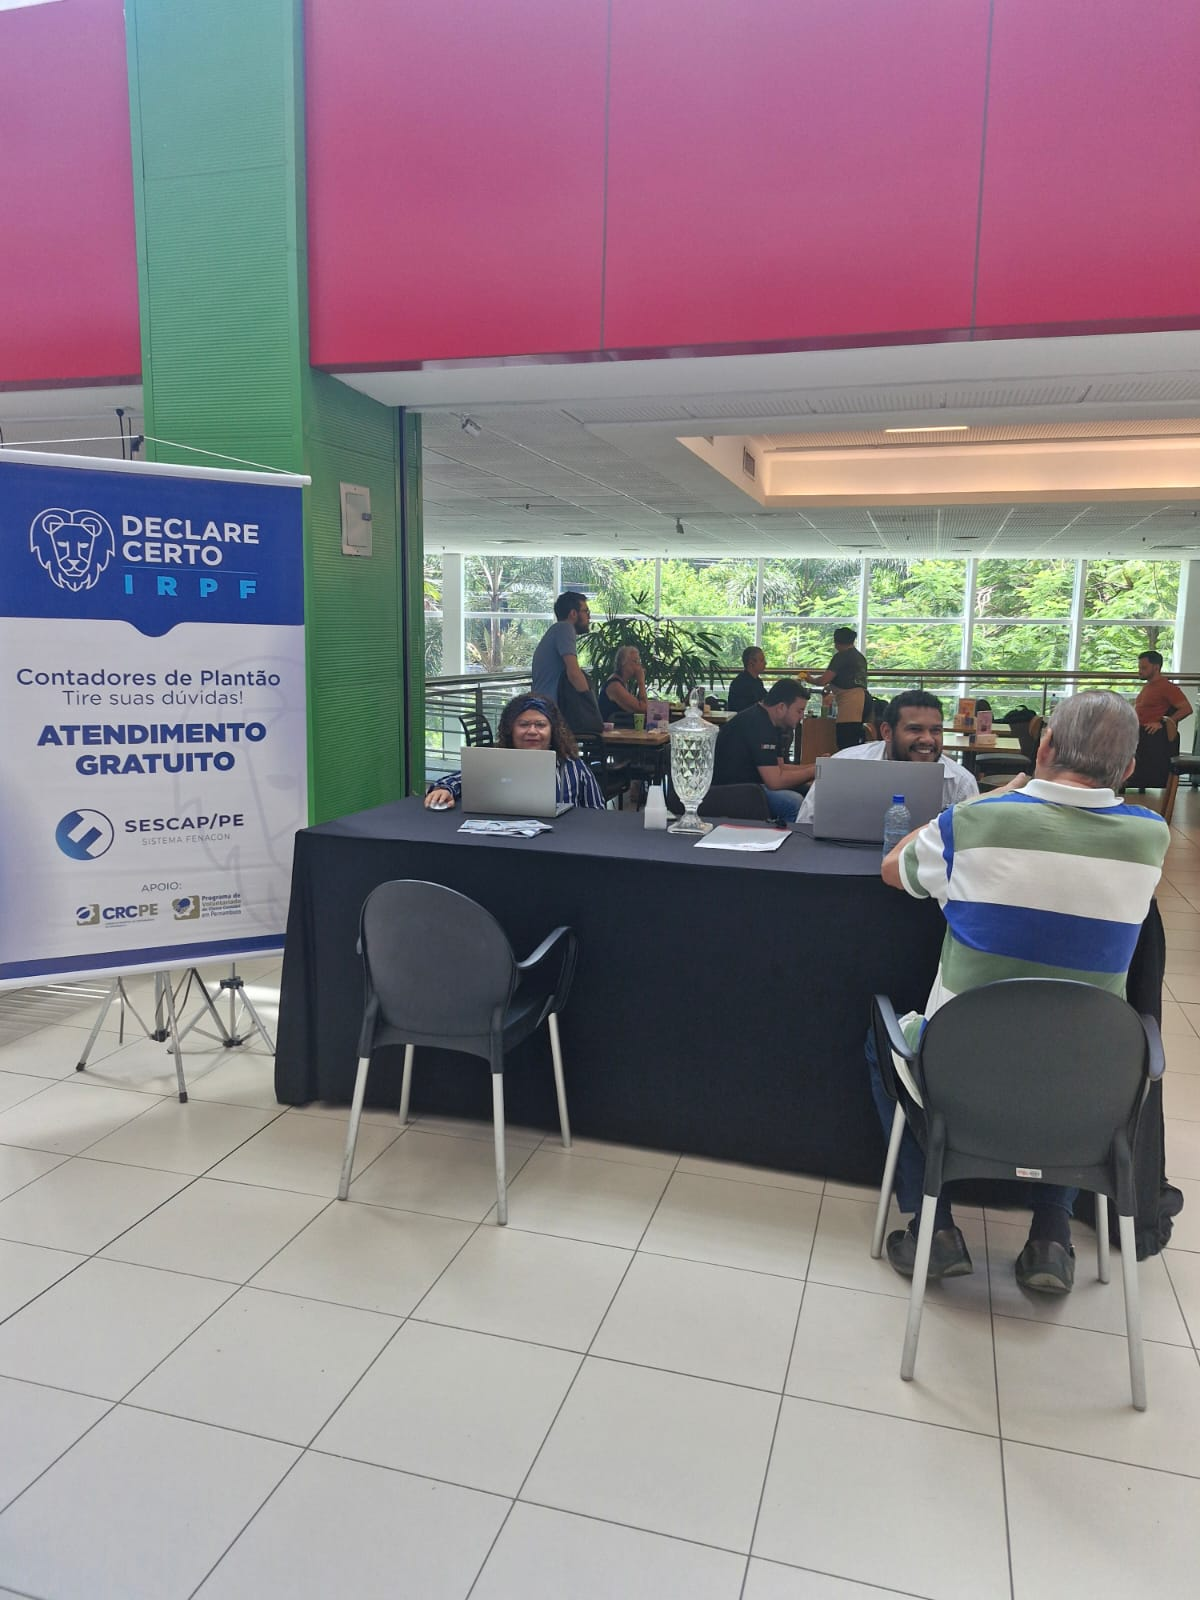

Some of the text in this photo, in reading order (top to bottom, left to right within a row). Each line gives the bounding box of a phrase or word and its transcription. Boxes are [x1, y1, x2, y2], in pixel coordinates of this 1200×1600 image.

[122, 515, 259, 544] DECLARE
[122, 541, 223, 566] CERTO
[16, 668, 281, 687] Contadores de Plantão
[62, 689, 244, 706] Tire suas dúvidas!
[37, 722, 267, 747] ATENDIMENTO
[75, 751, 236, 776] GRATUITO
[124, 813, 245, 833] SESCAP/PE
[142, 833, 231, 846] SISTEMA FENACON
[141, 881, 183, 893] APOIO:
[201, 894, 232, 903] Programa
[102, 903, 159, 920] CRCPE
